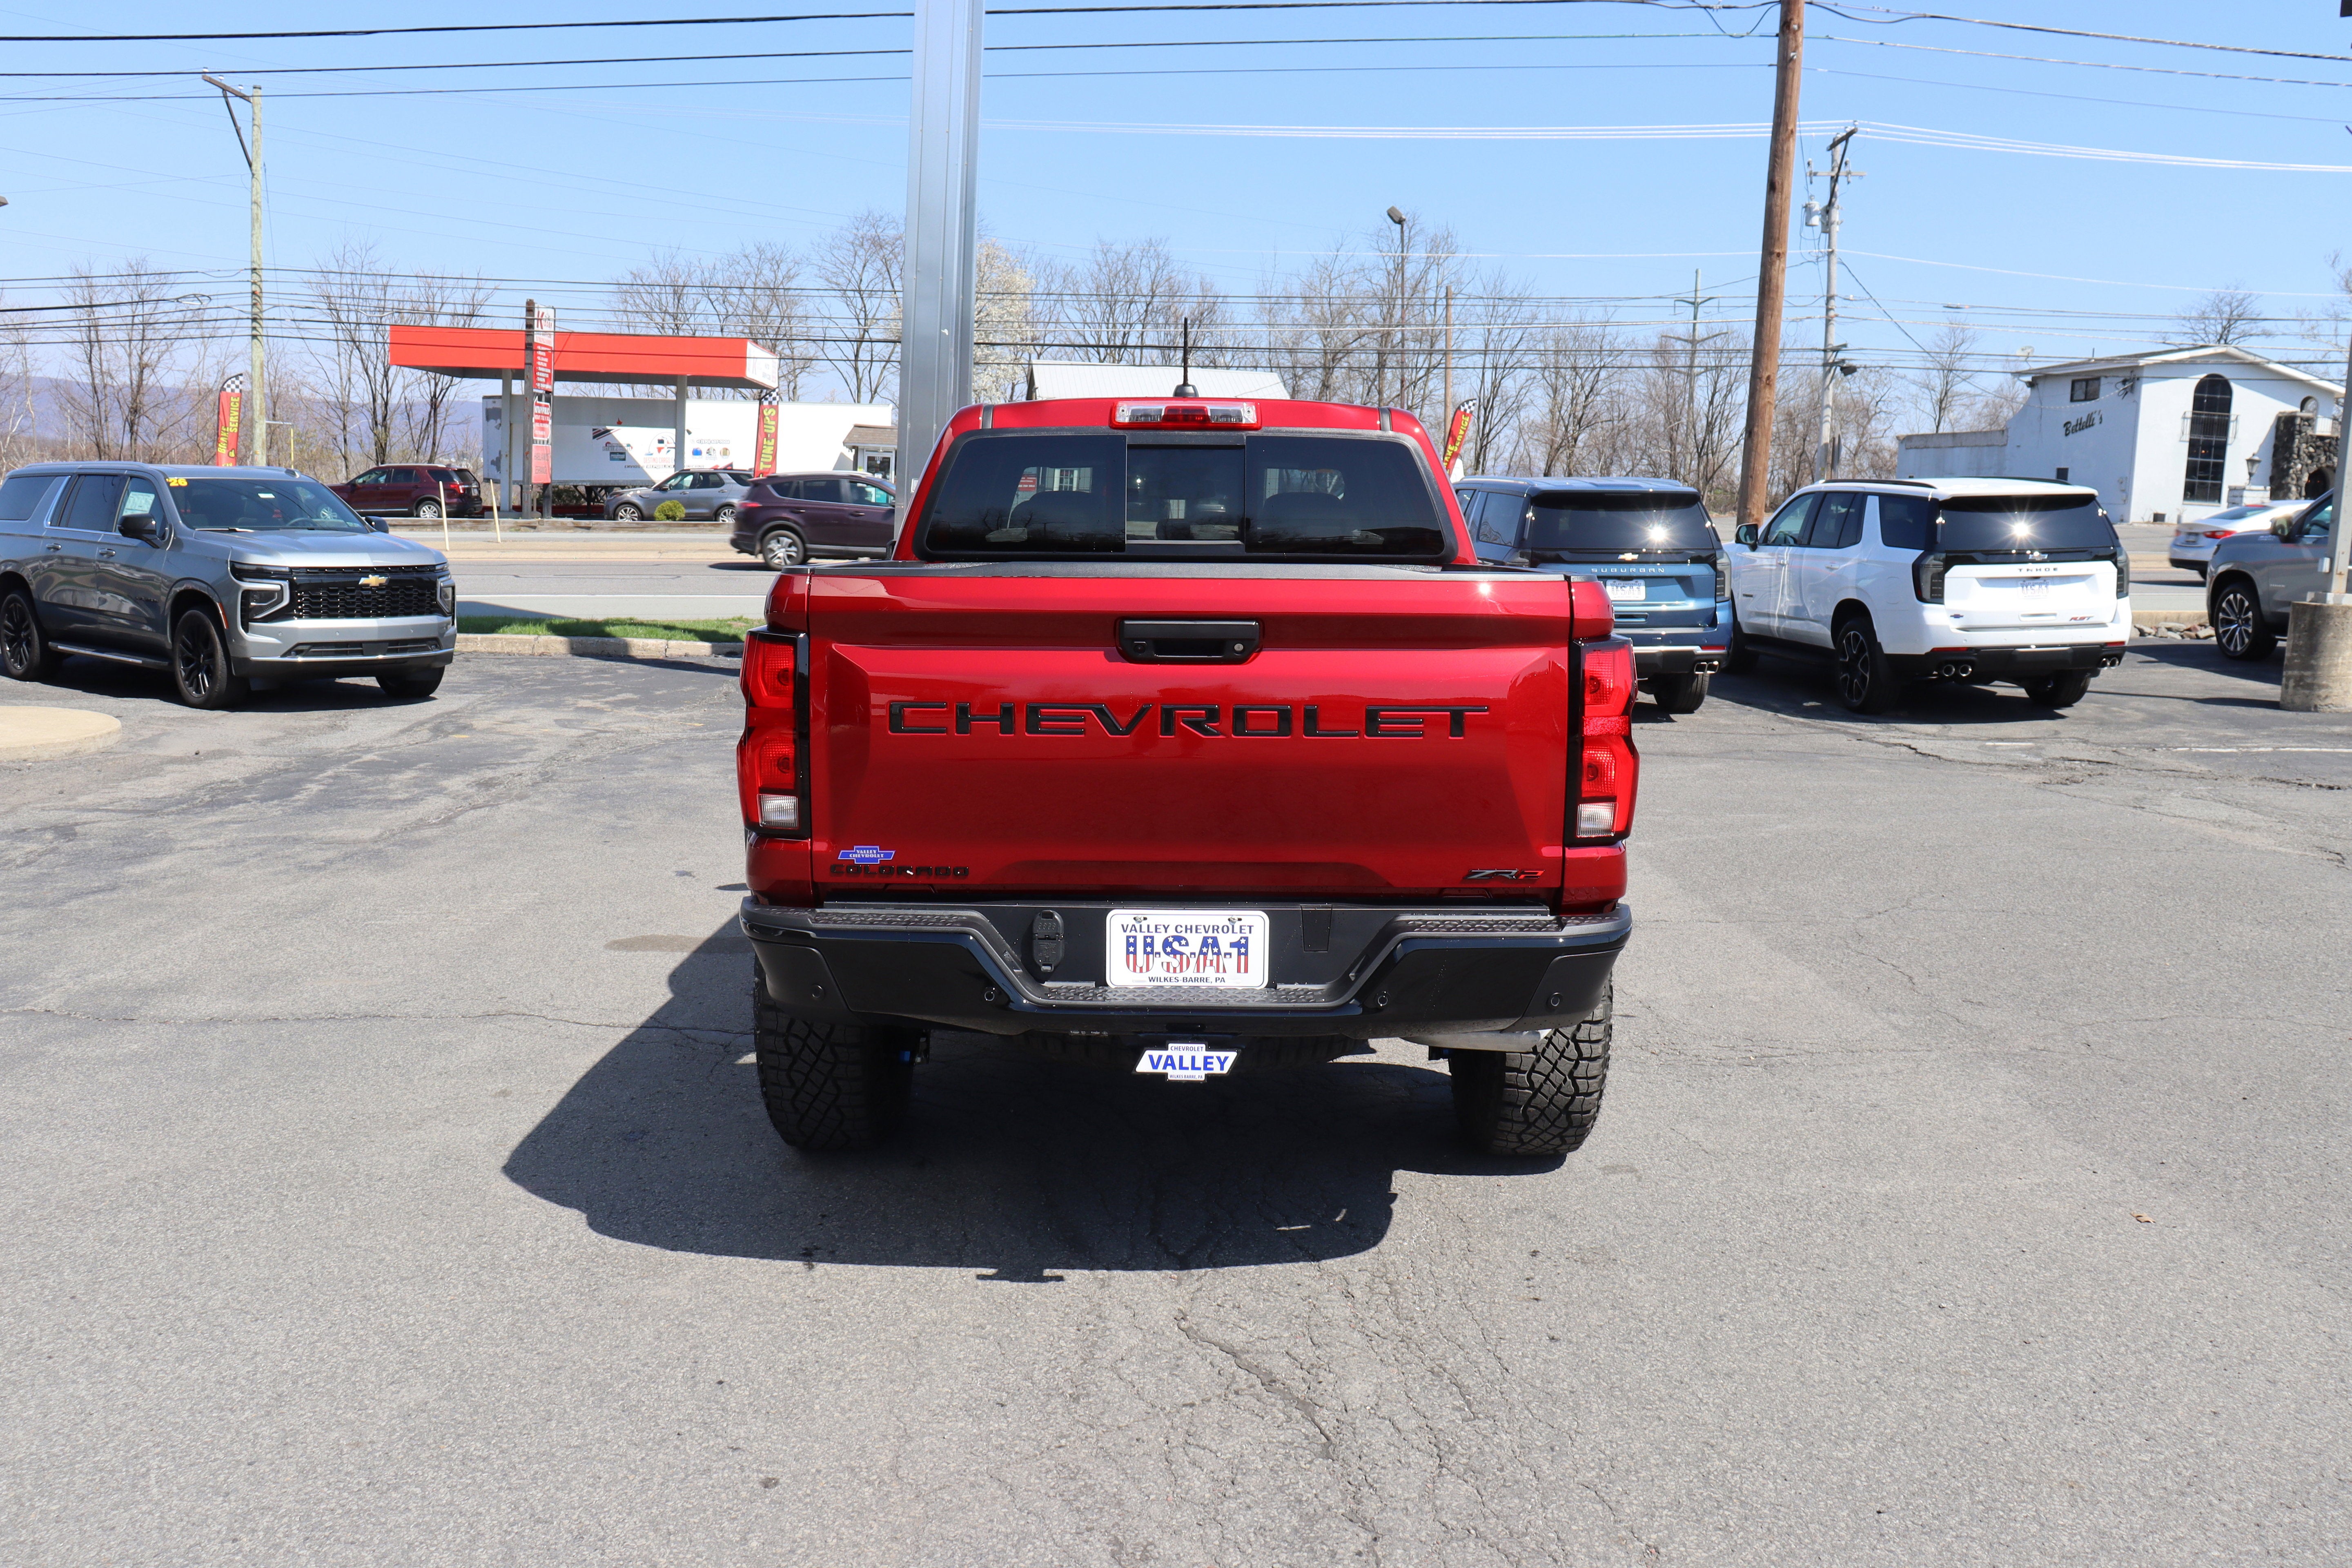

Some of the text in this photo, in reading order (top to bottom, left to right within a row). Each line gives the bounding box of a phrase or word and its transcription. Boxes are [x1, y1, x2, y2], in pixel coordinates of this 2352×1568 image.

[229, 396, 240, 433] SERVICE
[217, 425, 229, 454] BRAKE
[760, 408, 776, 470] TUNE-UPS
[889, 702, 1488, 737] CHEVROLET
[830, 864, 969, 877] COLORADO
[1463, 869, 1545, 880] ZR2
[1121, 924, 1254, 934] VALLEY CHEVROLET
[1148, 1054, 1229, 1071] VALLEY
